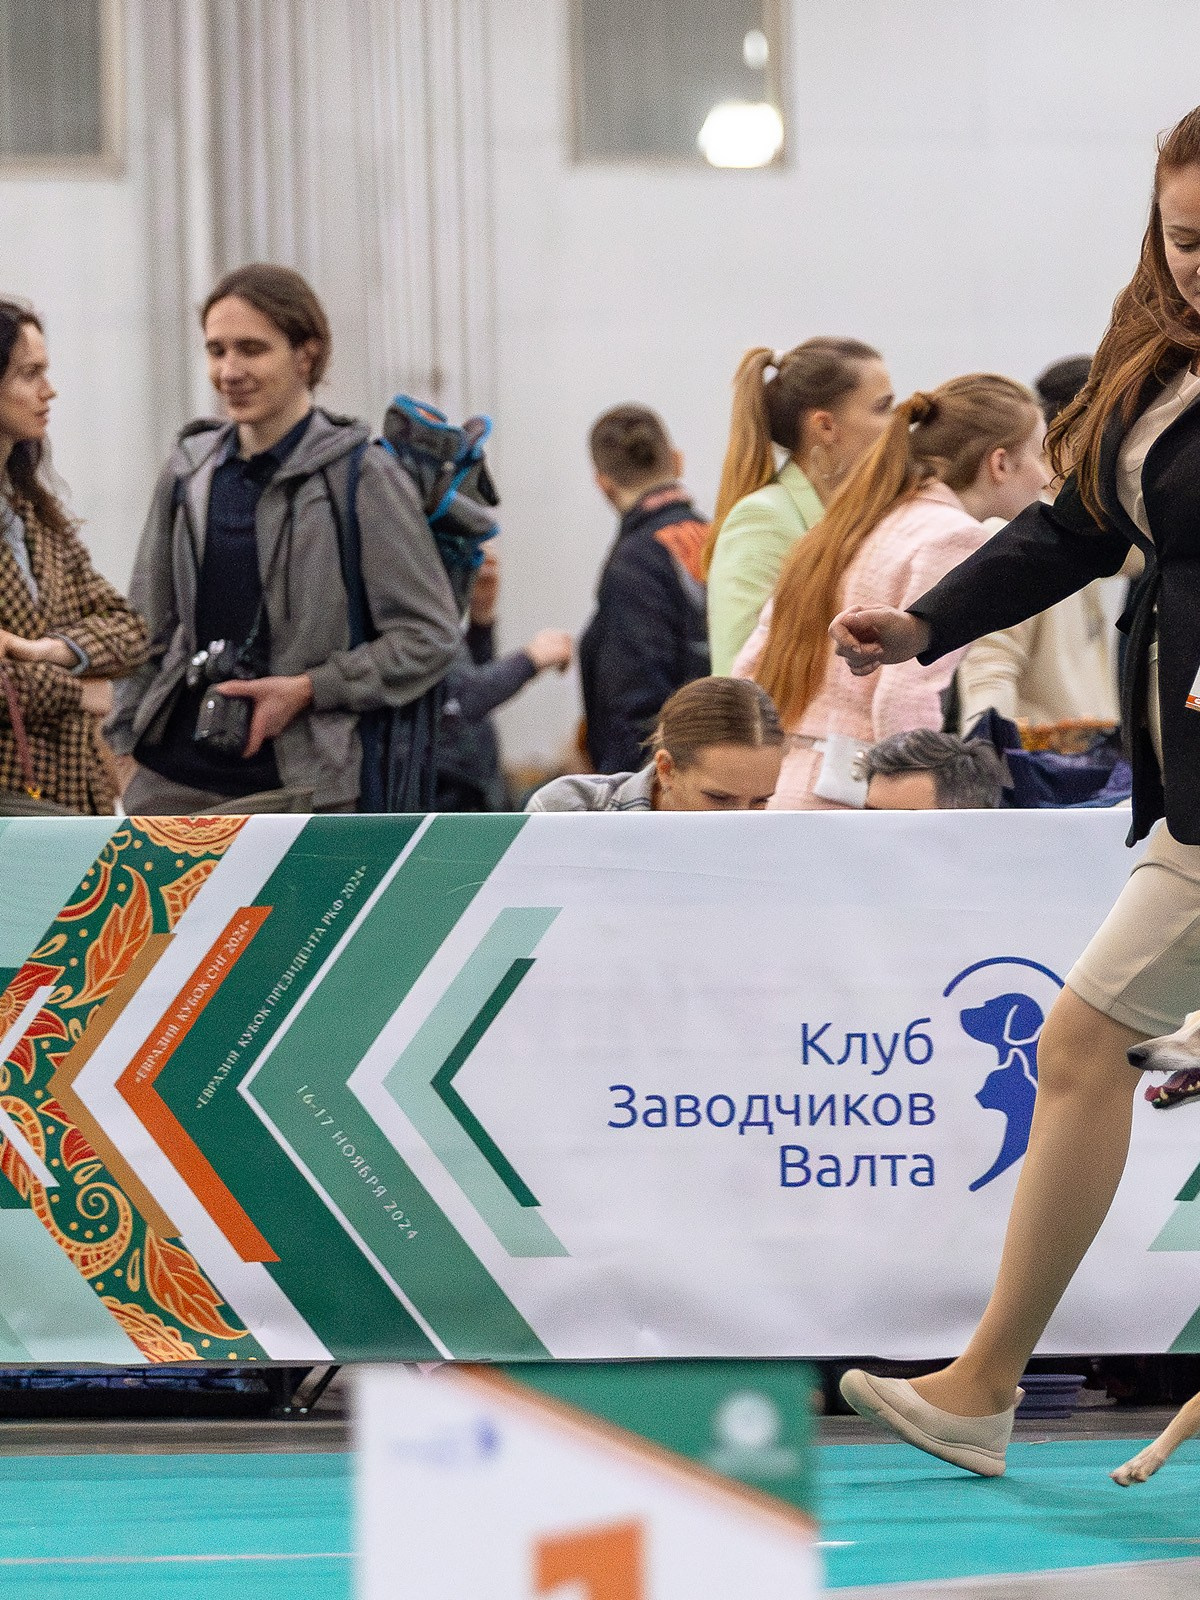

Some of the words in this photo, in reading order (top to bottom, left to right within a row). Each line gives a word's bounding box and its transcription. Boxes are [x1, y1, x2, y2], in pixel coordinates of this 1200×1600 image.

[800, 1017, 934, 1075] Клуб
[607, 1084, 936, 1135] Заводчиков
[296, 1084, 335, 1126] 16-17
[331, 1130, 388, 1198] НОЯБРЯ
[383, 1200, 419, 1239] 2024
[780, 1144, 935, 1187] Валта
